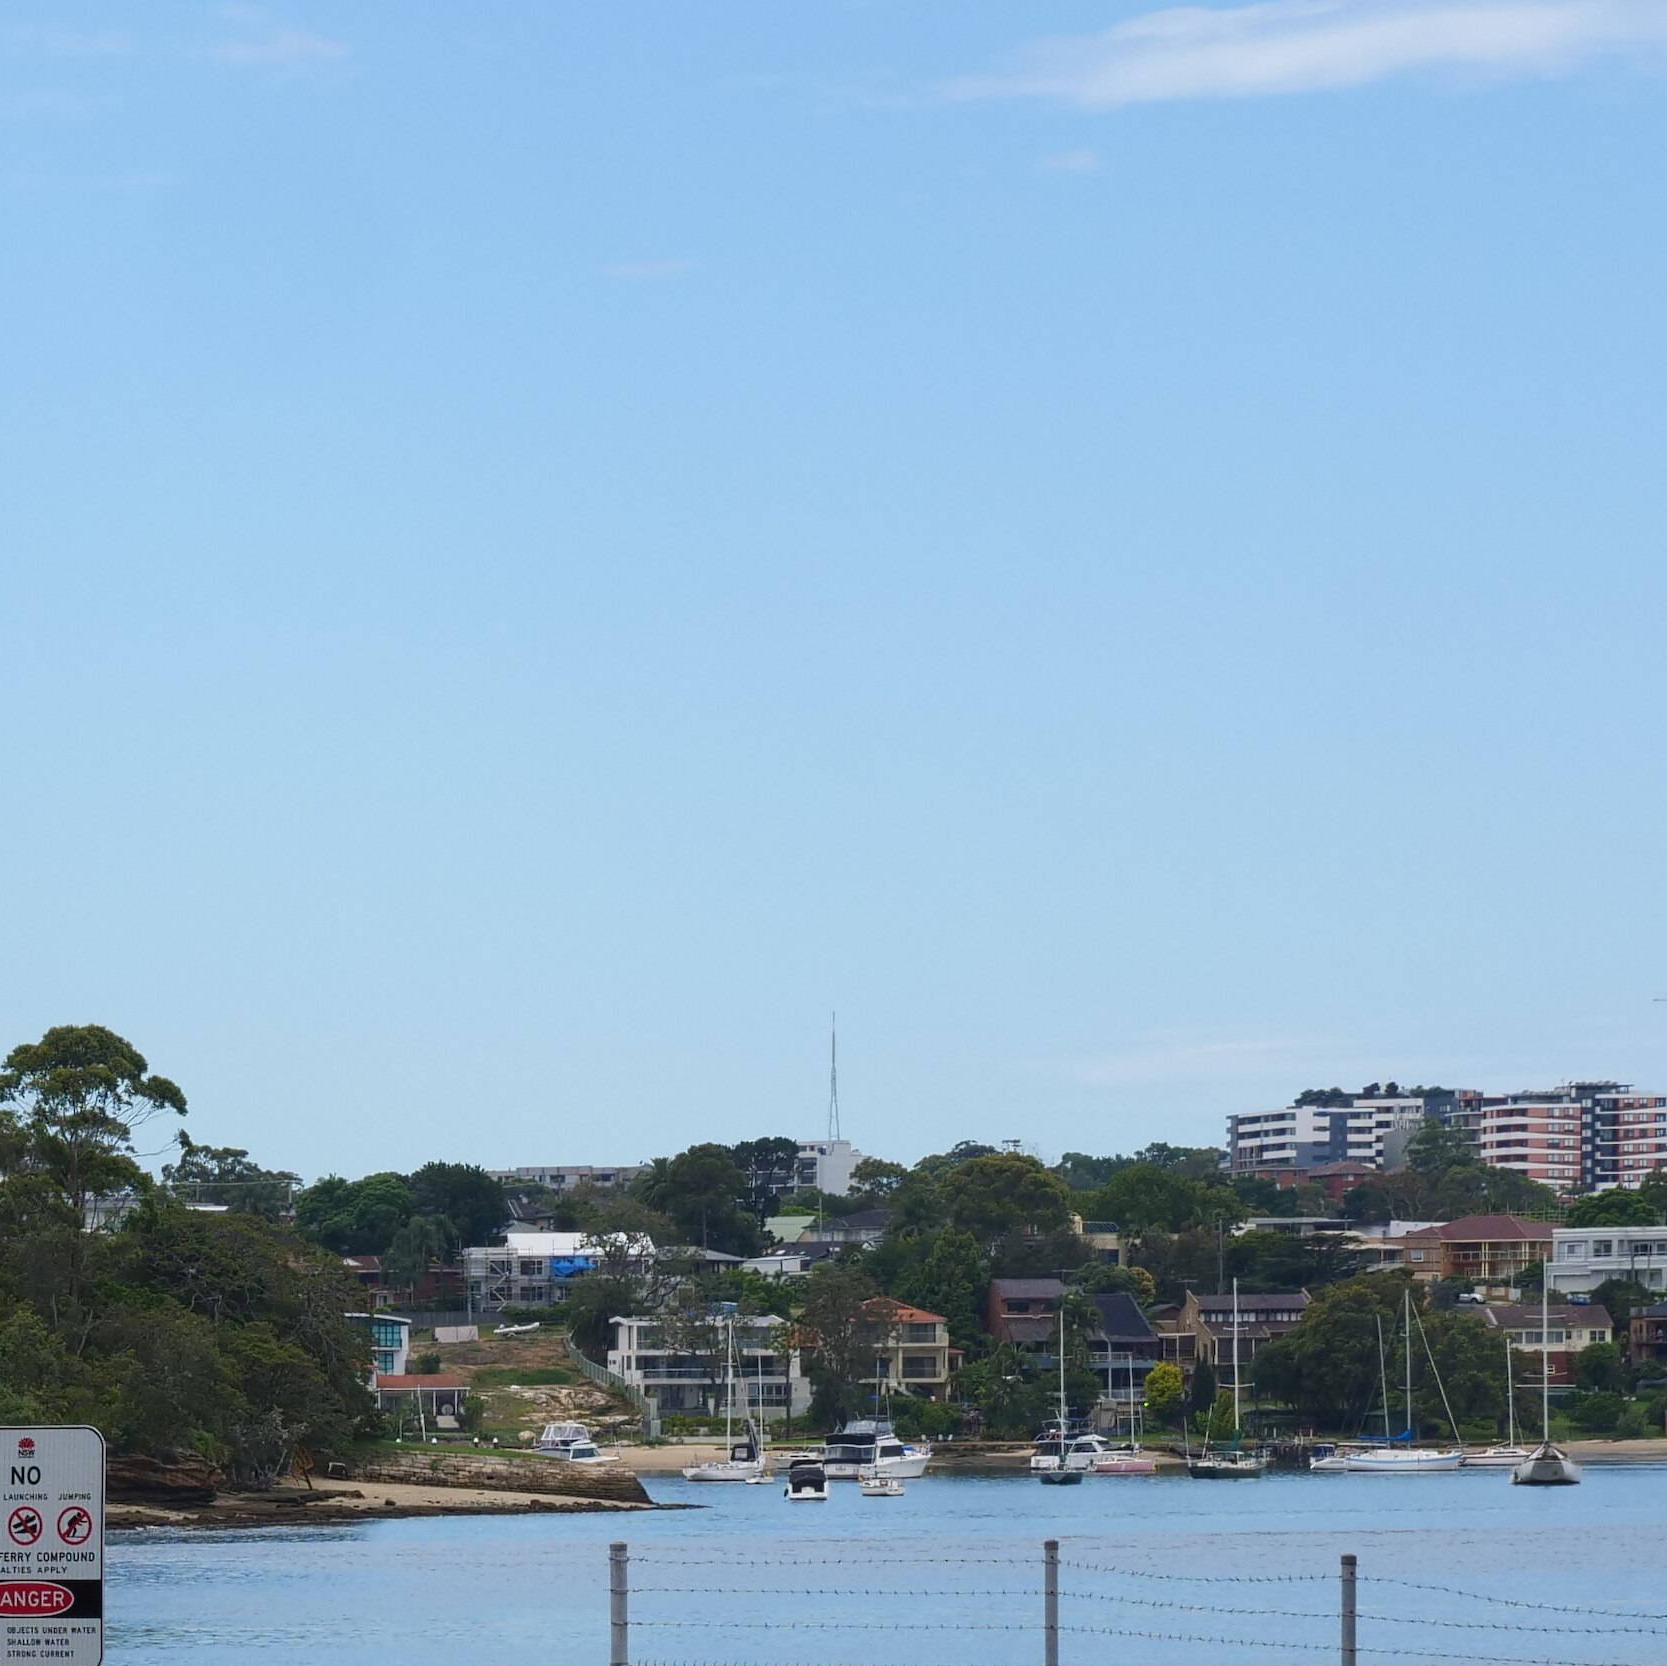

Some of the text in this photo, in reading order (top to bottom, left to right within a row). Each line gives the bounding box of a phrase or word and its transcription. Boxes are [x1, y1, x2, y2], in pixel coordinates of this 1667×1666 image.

[11, 1466, 41, 1485] NO
[3, 1493, 48, 1501] LAUNCHING
[57, 1493, 92, 1501] JUMPING
[36, 1552, 95, 1562] COMPOUND
[37, 1566, 67, 1574] APPLY
[6, 1626, 97, 1634] OBJECTS UNDER WATER
[6, 1638, 70, 1646] SHALLOW WATER
[6, 1650, 74, 1658] STRONG CURRENT
